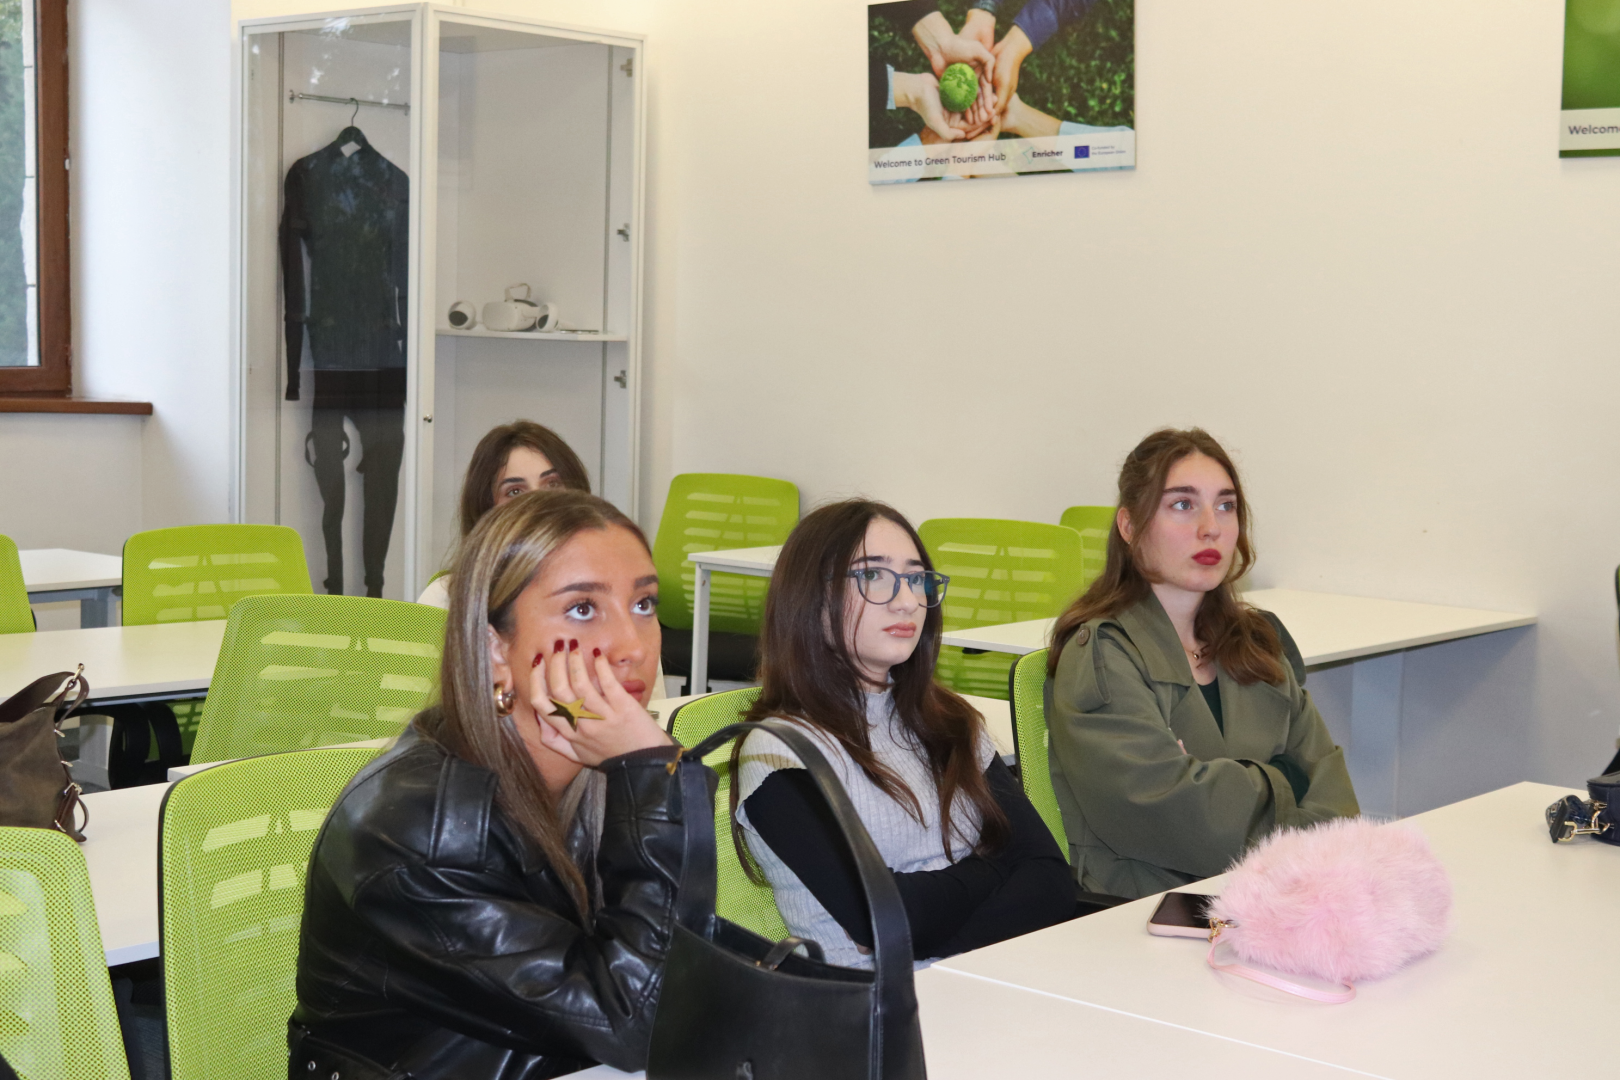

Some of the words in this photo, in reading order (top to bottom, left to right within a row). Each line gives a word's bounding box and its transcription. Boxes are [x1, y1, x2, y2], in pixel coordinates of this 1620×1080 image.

[1568, 124, 1620, 135] Welcom
[1032, 149, 1063, 158] Enricher
[874, 159, 912, 169] Welcome
[914, 158, 923, 166] to
[925, 157, 950, 165] Green
[952, 154, 986, 164] Tourism
[988, 153, 1006, 161] Hub
